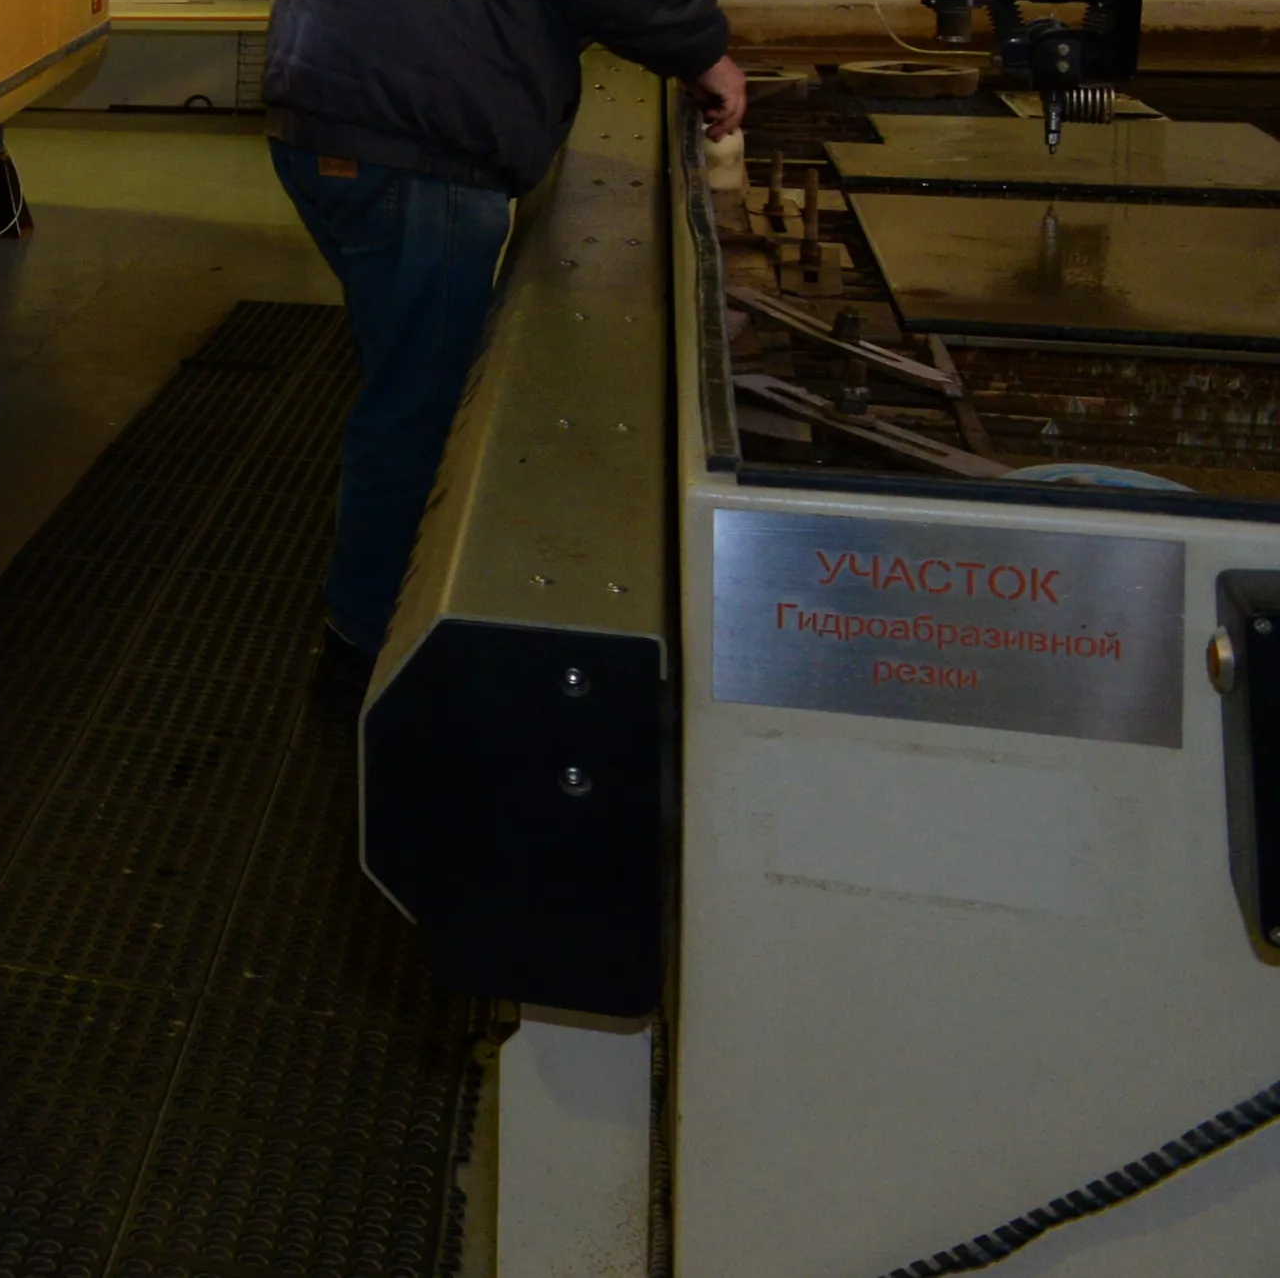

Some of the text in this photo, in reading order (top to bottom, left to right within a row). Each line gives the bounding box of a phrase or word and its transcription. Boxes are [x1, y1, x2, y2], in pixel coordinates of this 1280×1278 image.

[815, 550, 1061, 604] УЧАСТОК
[776, 602, 1122, 660] Гидроабразивной
[872, 659, 979, 690] резки
